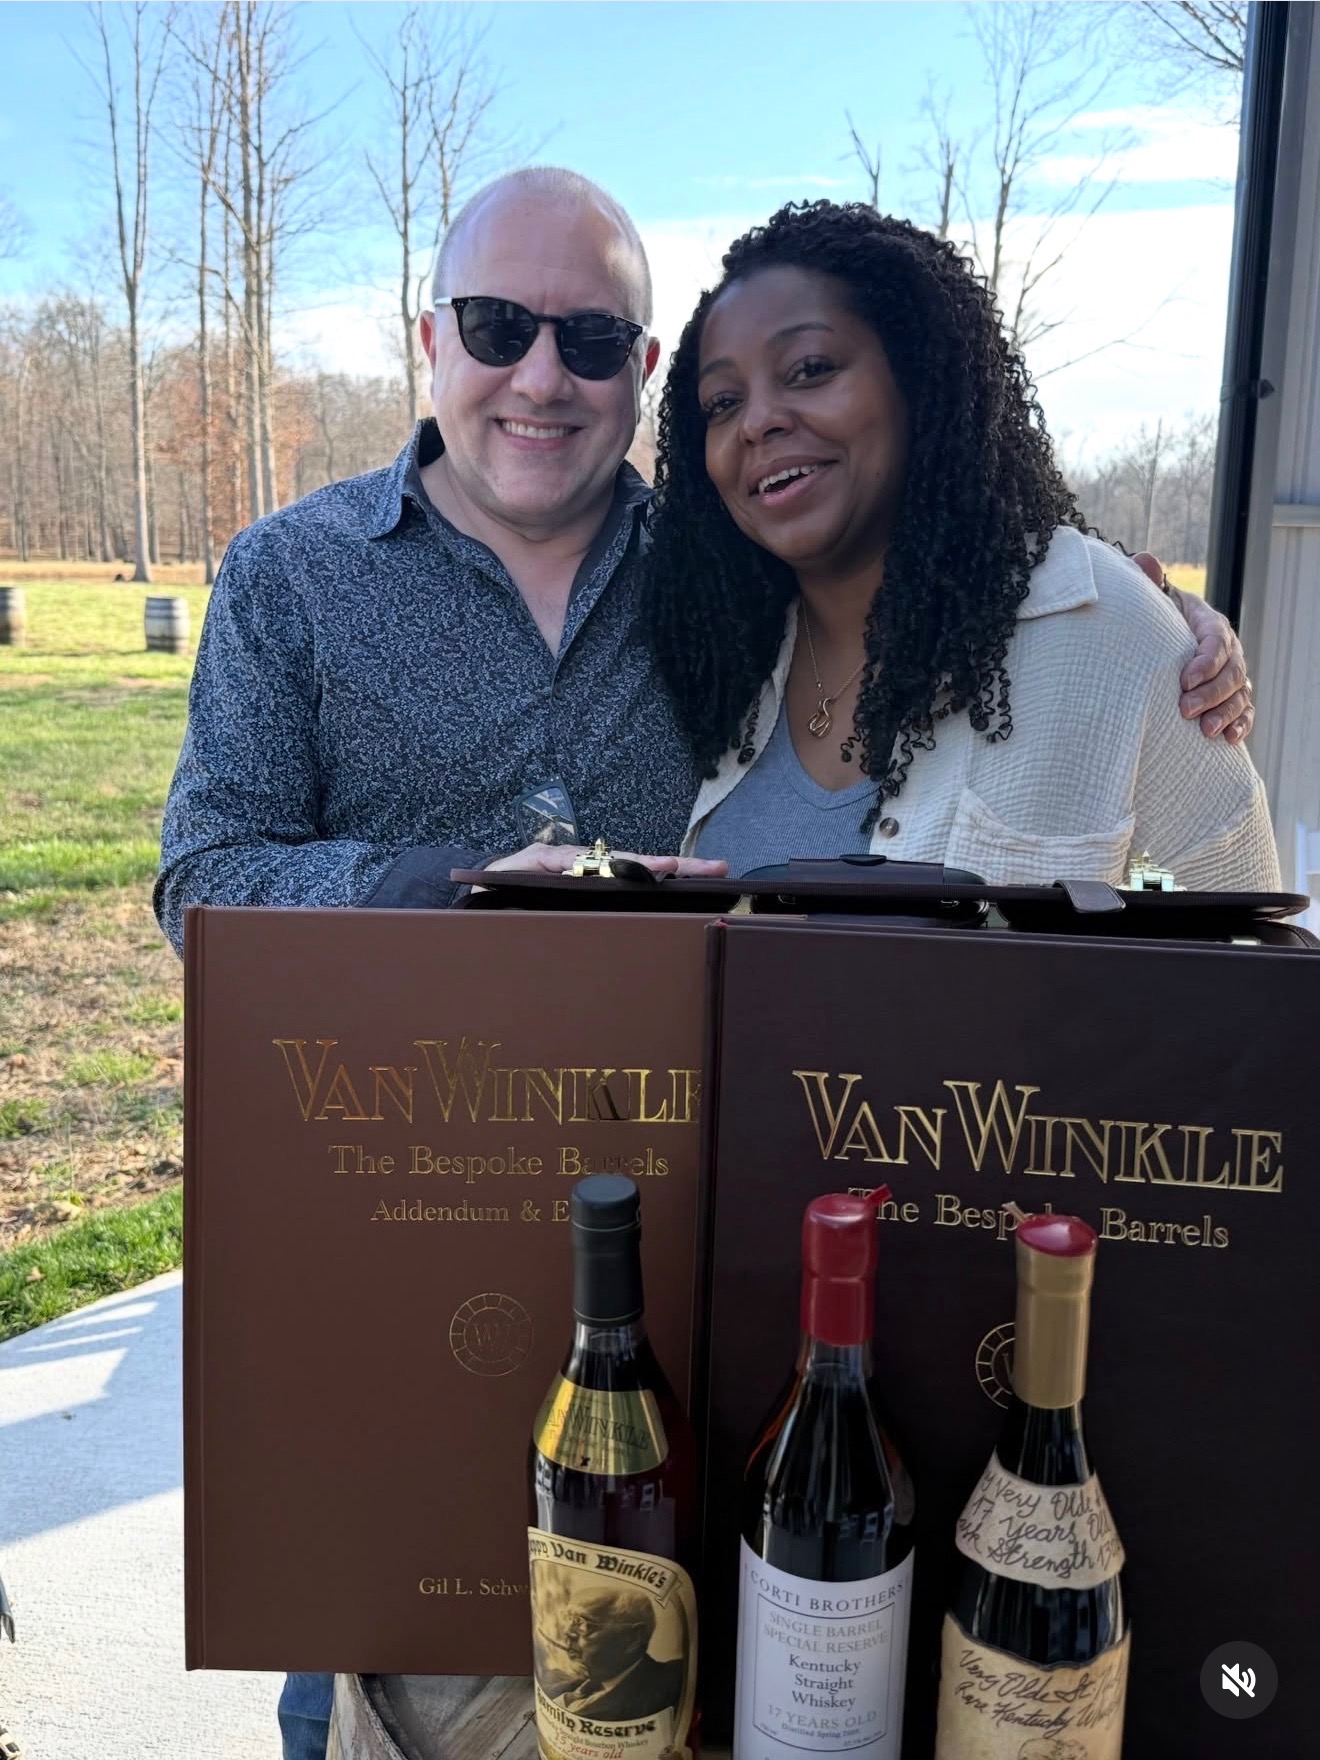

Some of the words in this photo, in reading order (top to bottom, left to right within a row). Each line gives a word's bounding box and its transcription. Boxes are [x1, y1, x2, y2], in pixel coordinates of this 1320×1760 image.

[791, 1069, 947, 1172] VAN
[943, 1079, 1284, 1193] WINKLE
[328, 1145, 395, 1174] The
[408, 1145, 543, 1184] Bespoke
[370, 1199, 510, 1221] Addendum
[520, 1199, 541, 1222] &
[1099, 1207, 1230, 1249] Barrels
[972, 1495, 996, 1520] 17
[995, 1477, 1041, 1518] Very
[551, 1541, 587, 1565] Van
[595, 1553, 667, 1589] Winkle's
[987, 1538, 1095, 1579] Strength
[419, 1577, 448, 1594] Gil
[455, 1578, 473, 1594] L.
[480, 1578, 529, 1596] Schw
[750, 1570, 800, 1607] CORTI
[809, 1584, 903, 1612] BROTHERS
[769, 1611, 823, 1637] SINGLE
[826, 1619, 882, 1638] BARREL
[764, 1625, 821, 1653] SPECIAL
[827, 1631, 888, 1653] RESERVE
[789, 1653, 861, 1675] Kentucky
[959, 1650, 1001, 1691] Very
[794, 1673, 854, 1694] Straight
[792, 1690, 856, 1712] Whiskey
[580, 1719, 656, 1738] Reserve
[768, 1704, 782, 1718] 17
[786, 1710, 840, 1730] YEARS
[844, 1711, 877, 1727] OLD
[992, 1702, 1076, 1739] Kentucky
[569, 1742, 598, 1758] years
[602, 1748, 624, 1760] old
